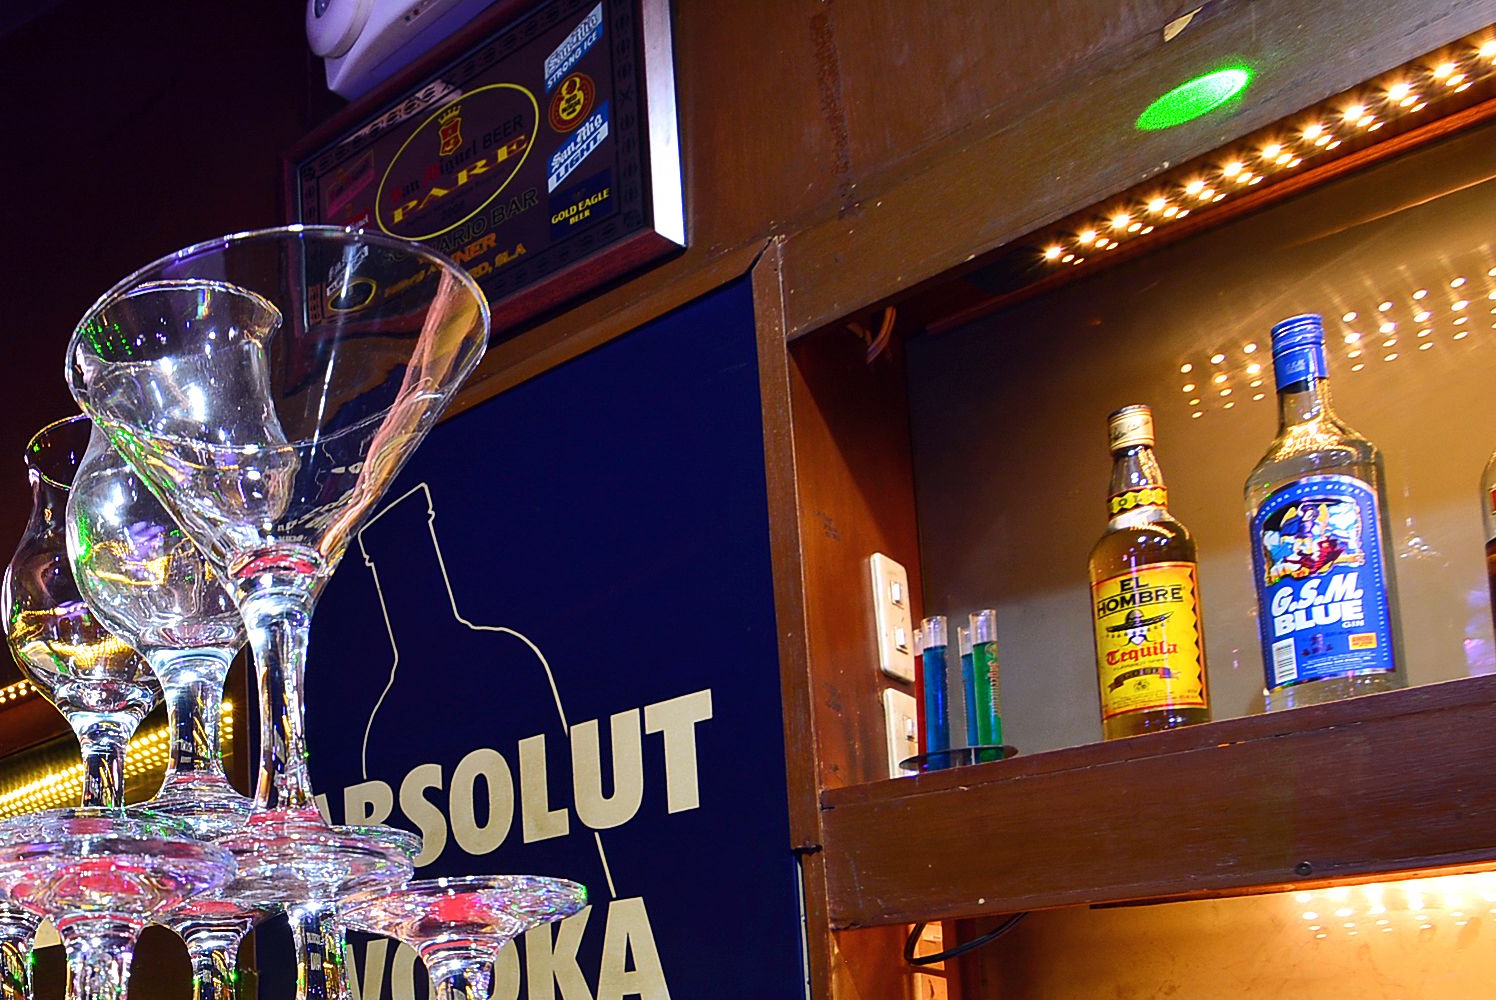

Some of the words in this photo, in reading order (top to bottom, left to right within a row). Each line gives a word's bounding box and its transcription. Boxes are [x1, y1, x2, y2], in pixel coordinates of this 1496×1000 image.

[547, 48, 583, 89] STRONG
[582, 32, 598, 49] ICE
[483, 115, 523, 149] BEER
[491, 187, 539, 226] BAR
[551, 200, 578, 225] GOLD
[578, 188, 610, 212] EAGLE
[569, 209, 591, 225] BEER
[1097, 586, 1184, 618] HOMBRE
[1119, 576, 1149, 593] EL
[1271, 572, 1364, 617] G.S.M.
[1273, 599, 1365, 637] BLUE
[1105, 639, 1177, 667] Tequila
[315, 688, 713, 868] SOLUT
